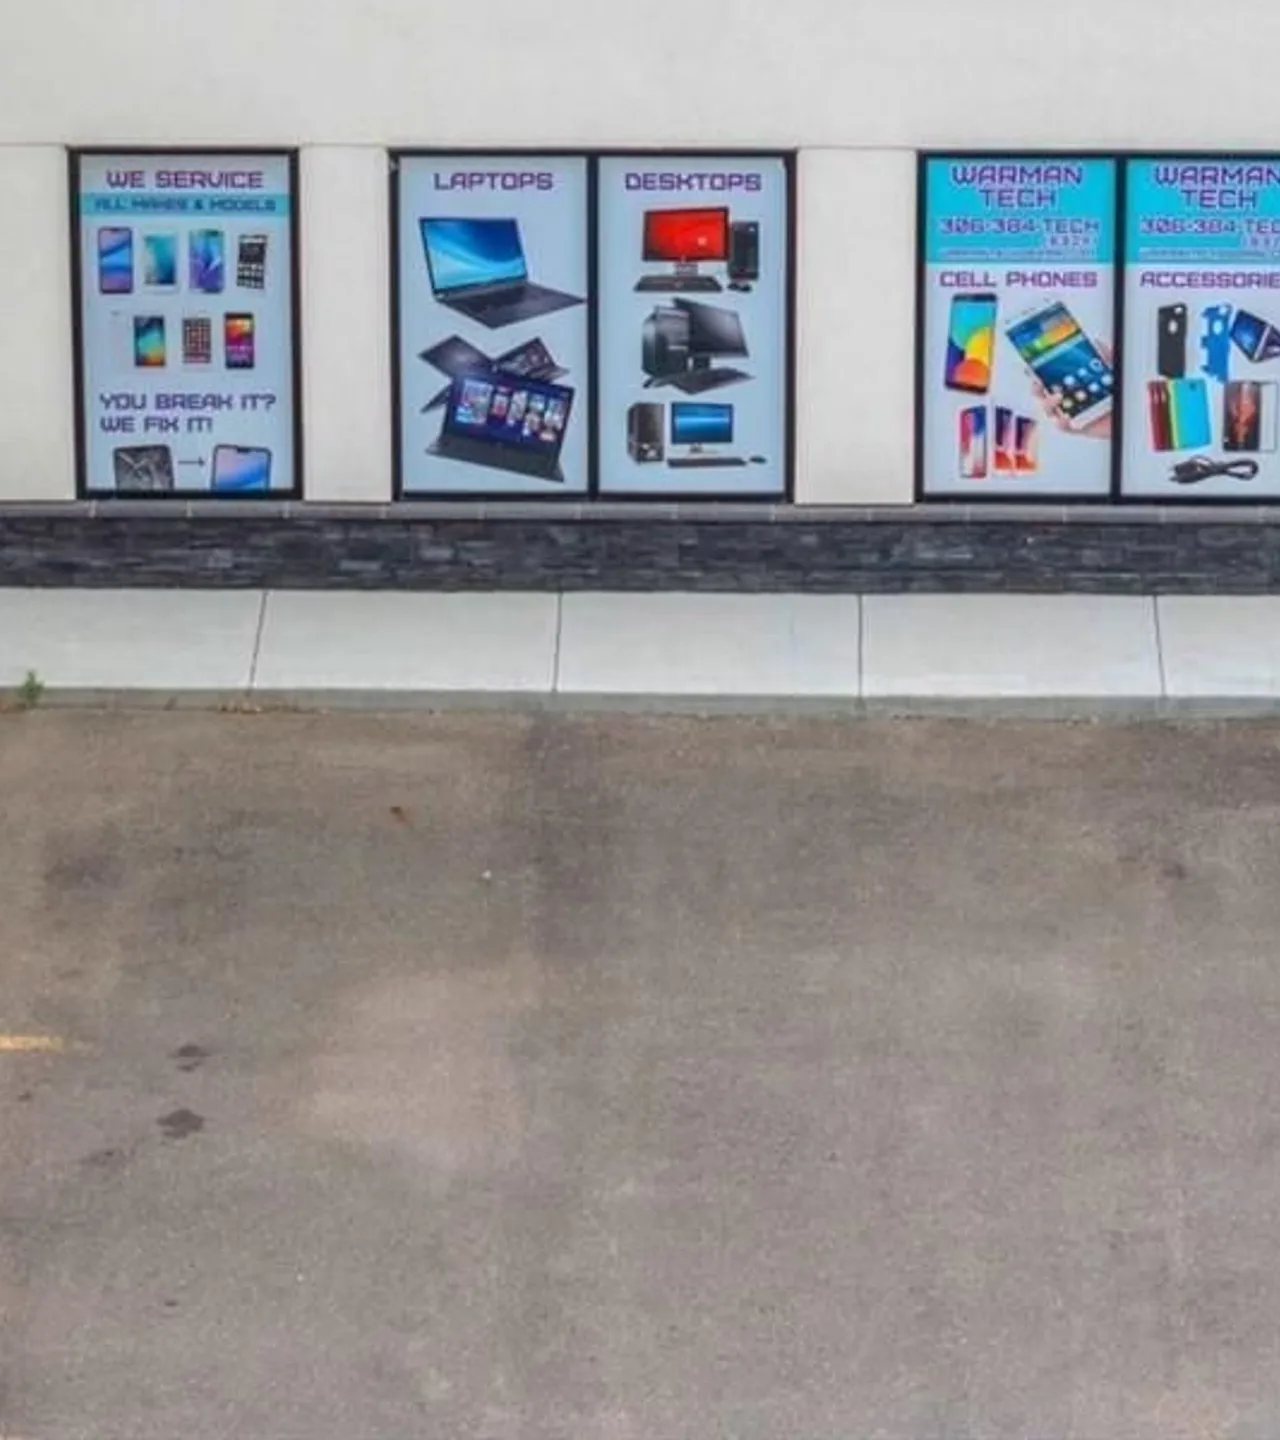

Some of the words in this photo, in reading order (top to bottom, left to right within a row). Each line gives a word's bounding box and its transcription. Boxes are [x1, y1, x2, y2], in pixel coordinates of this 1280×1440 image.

[106, 170, 146, 189] WE
[155, 170, 264, 189] SERVICE
[433, 171, 554, 192] LAPTOPS
[624, 172, 762, 192] DESKTOPS
[951, 165, 1083, 185] WARMAN
[980, 189, 1056, 208] TECH
[1181, 189, 1257, 208] TECH
[939, 271, 997, 288] CELL
[1006, 271, 1098, 288] PHONES
[100, 393, 147, 410] YOU
[155, 393, 233, 410] BREAK
[240, 393, 277, 411] IT?
[100, 417, 135, 433] WE
[144, 417, 180, 433] FIX
